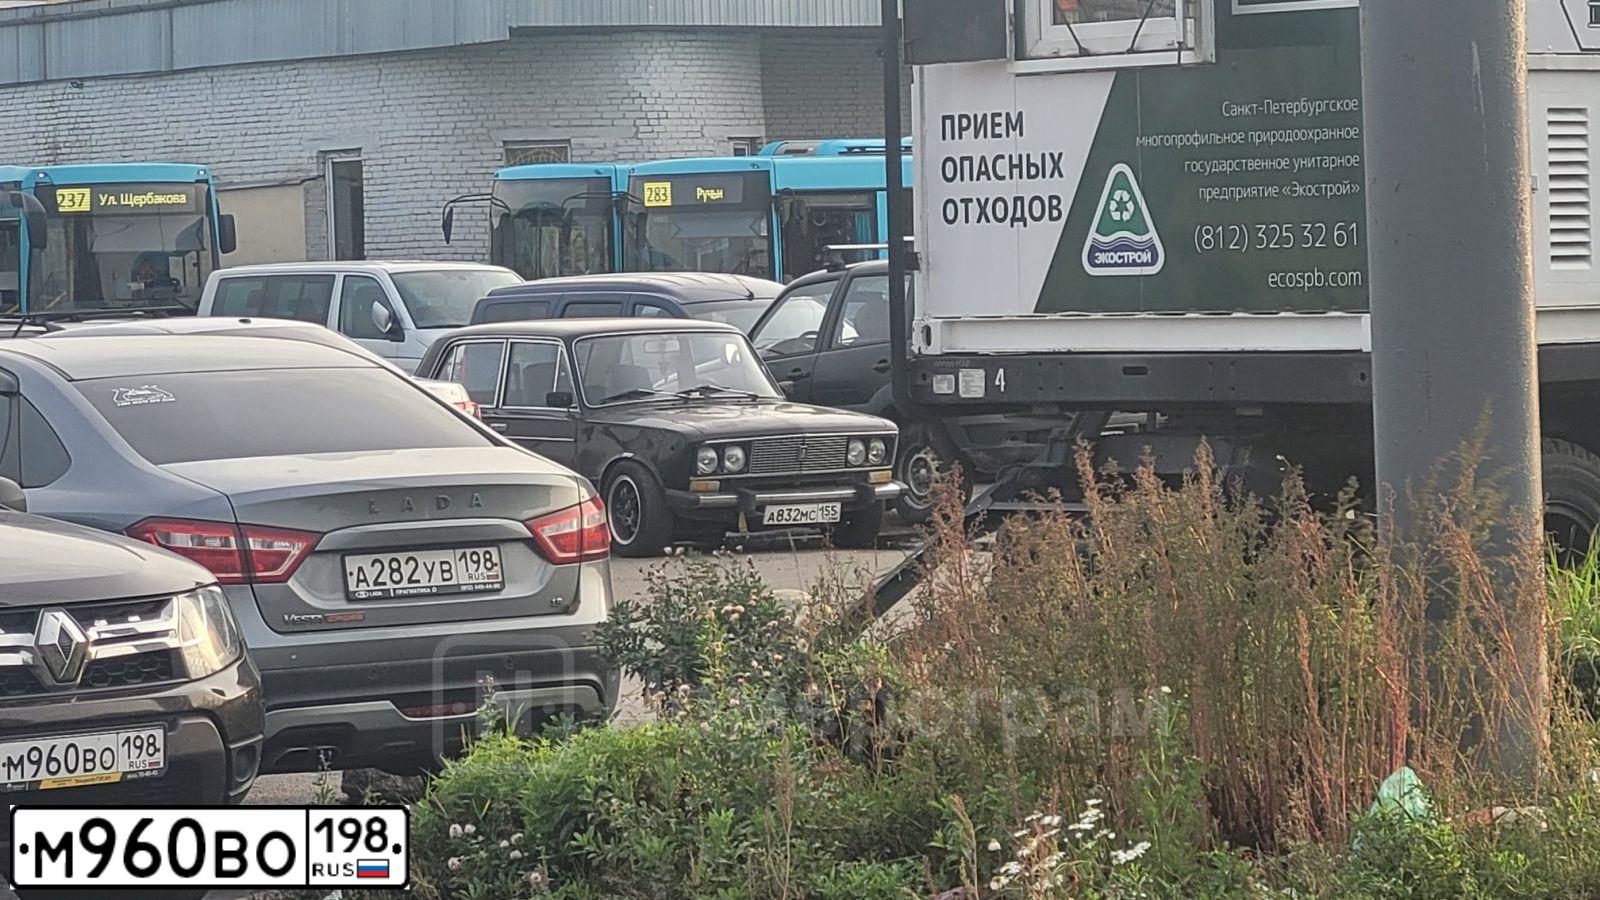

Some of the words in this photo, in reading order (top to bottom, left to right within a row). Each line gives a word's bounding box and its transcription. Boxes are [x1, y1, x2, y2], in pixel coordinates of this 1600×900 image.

[1222, 98, 1359, 117] Санкт-Петербургское
[941, 111, 1024, 141] ПРИЕМ
[1136, 131, 1245, 148] многопрофильное
[1248, 126, 1360, 144] природоохранное
[941, 151, 1064, 183] ОПАСНЫХ
[1184, 158, 1290, 176] государственное
[1292, 154, 1360, 172] унитарное
[58, 192, 86, 208] 237
[120, 192, 187, 208] Щербакова
[647, 187, 668, 202] 283
[696, 186, 724, 203] Ручьи
[1199, 184, 1279, 202] предприятие
[1282, 180, 1360, 198] «Экострой»
[942, 194, 1063, 228] ОТХОДОВ
[1194, 224, 1249, 252] (812)
[1256, 223, 1293, 249] 325
[1301, 222, 1326, 248] 32
[1333, 222, 1358, 247] 61
[1094, 250, 1152, 264] ЭКОСТРОЙ
[1268, 267, 1362, 291] ecospb.com
[995, 368, 1005, 392] 4
[368, 492, 485, 514] LADA
[818, 505, 838, 518] 155
[355, 556, 454, 588] А282УВ
[458, 550, 494, 573] 198
[468, 572, 486, 581] RUS
[7, 742, 116, 780] М960ВО
[121, 733, 157, 760] 198
[128, 760, 147, 770] RUS
